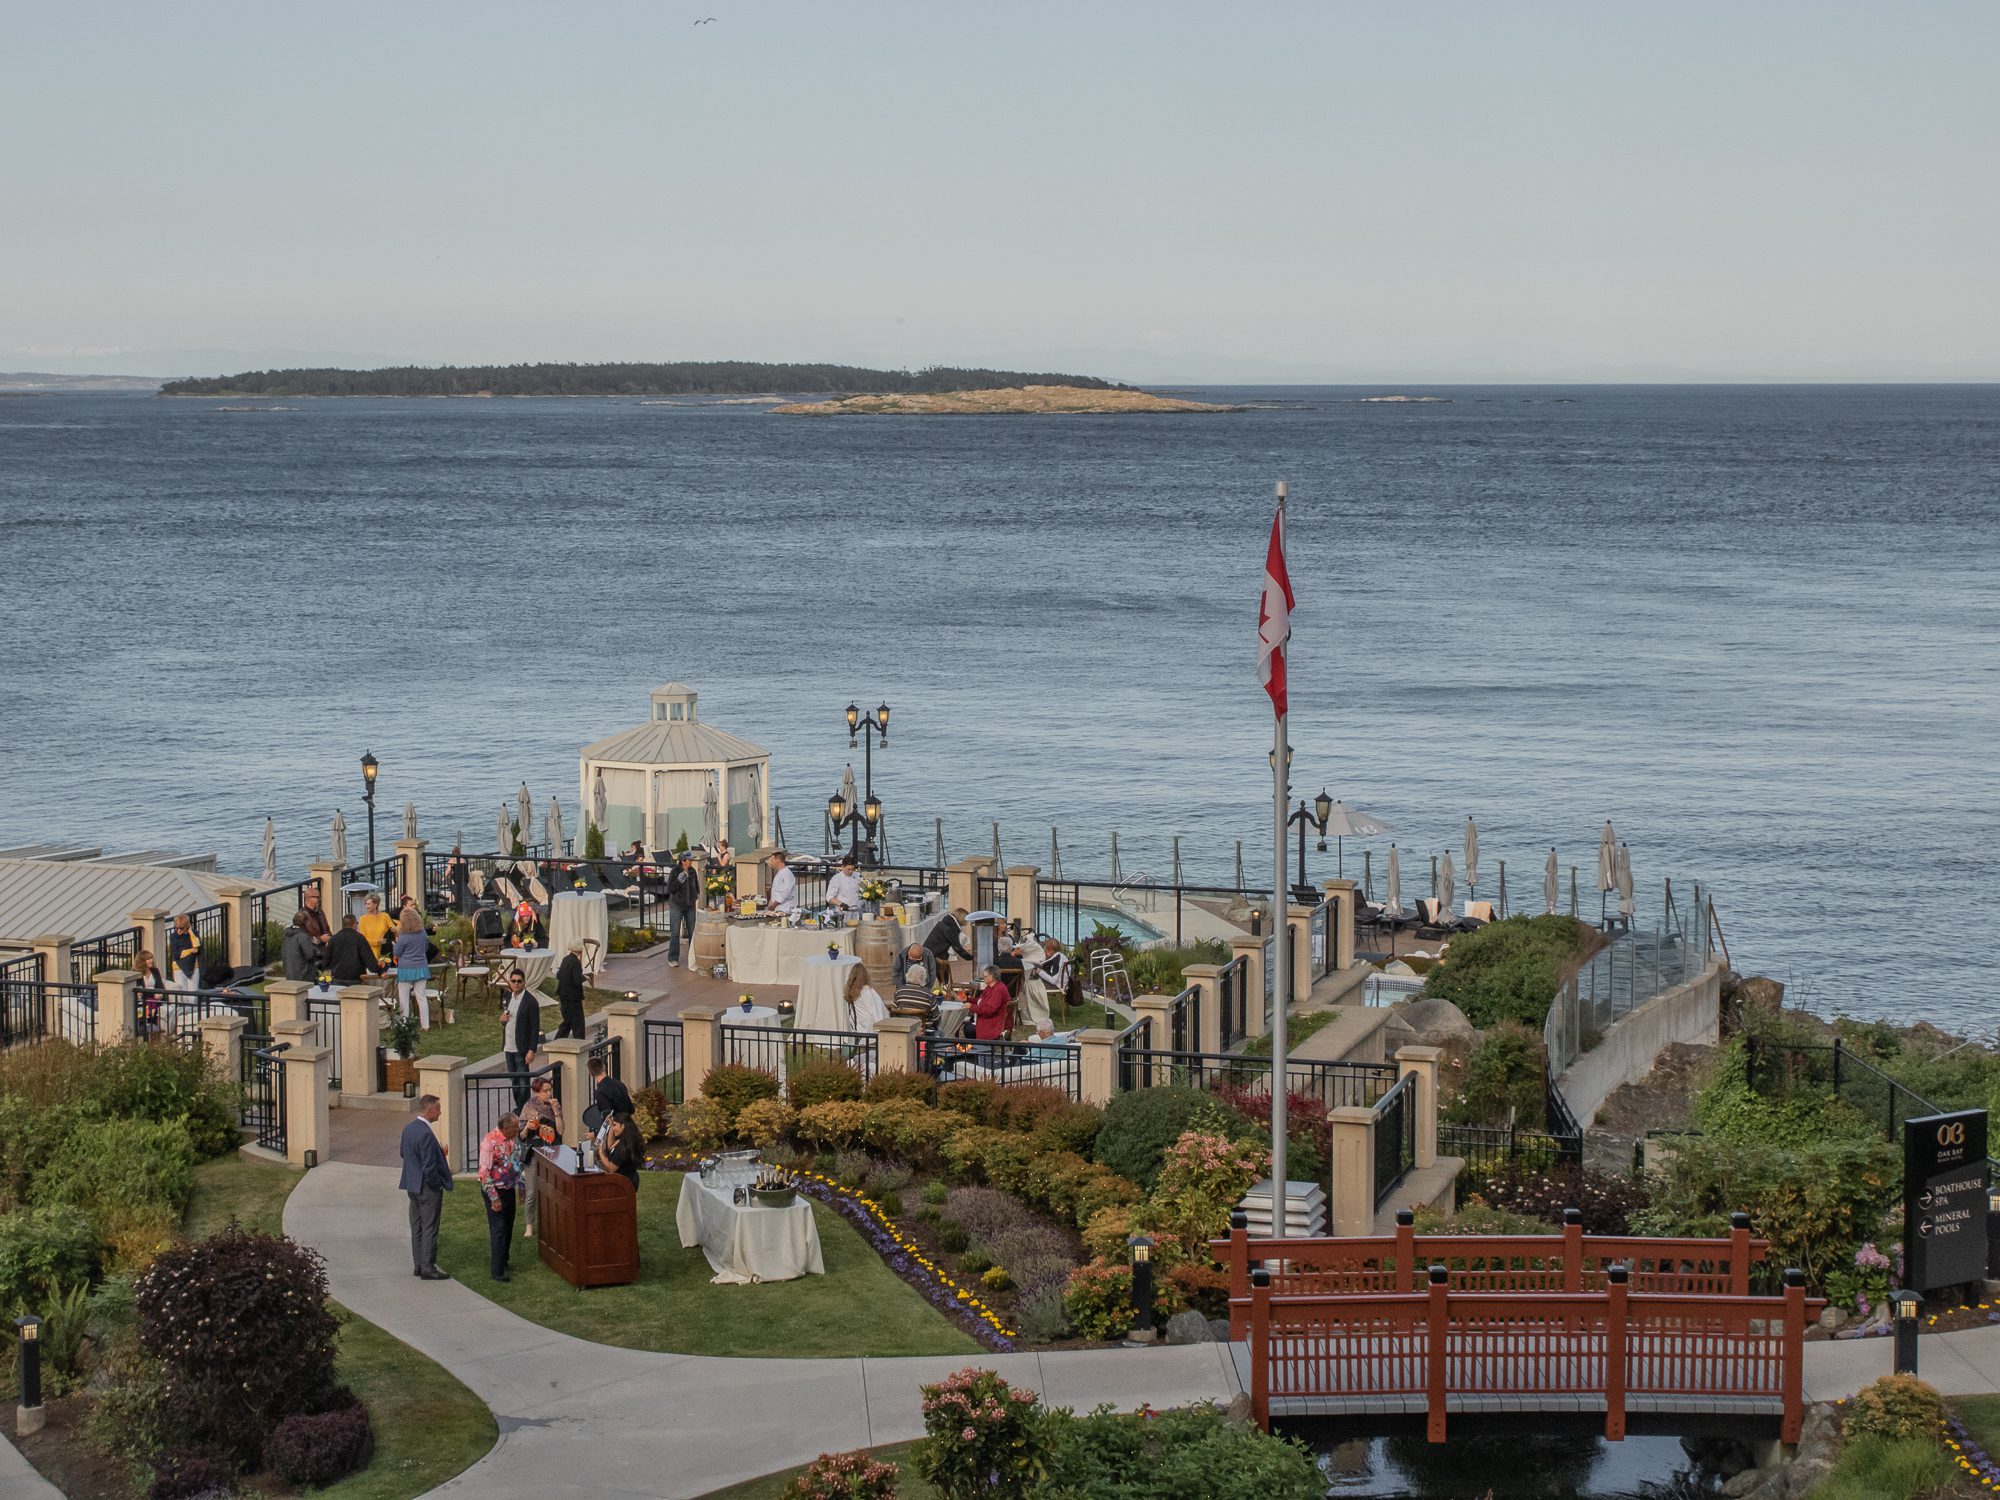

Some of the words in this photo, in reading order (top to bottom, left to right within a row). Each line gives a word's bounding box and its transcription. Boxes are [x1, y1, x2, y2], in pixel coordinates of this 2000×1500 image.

[1935, 1178, 1982, 1195] BOATHOUSE
[1935, 1196, 1949, 1206] SPA
[1935, 1209, 1970, 1223] MINERAL
[1935, 1222, 1960, 1235] POOLS
